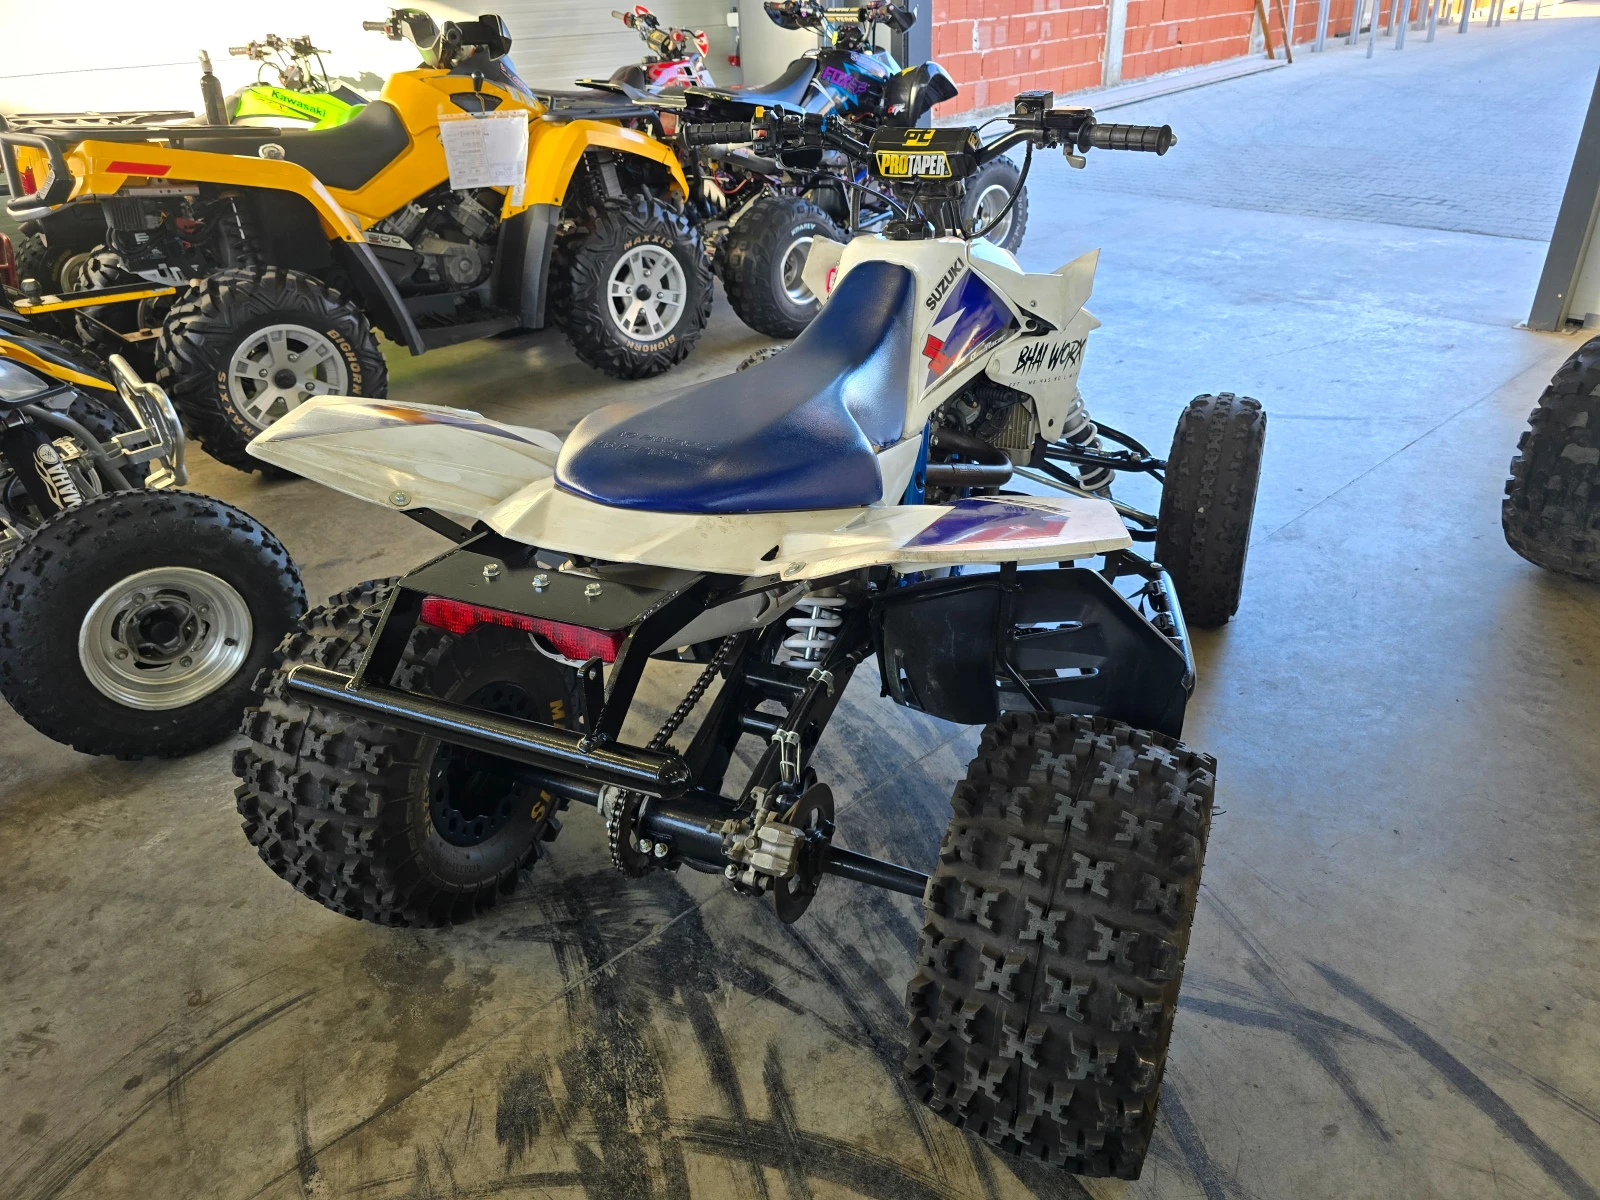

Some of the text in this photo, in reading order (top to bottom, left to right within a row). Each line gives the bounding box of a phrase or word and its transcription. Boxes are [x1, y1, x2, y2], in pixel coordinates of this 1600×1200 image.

[821, 65, 852, 89] FOX
[271, 89, 327, 119] Kawasaki
[881, 153, 947, 176] PROTAPER
[623, 234, 674, 251] MAXXIS
[925, 257, 965, 311] SUZUKI
[626, 333, 676, 353] BIGHORN
[326, 328, 362, 396] BIGHORN
[1011, 341, 1050, 377] BHAI
[217, 370, 255, 437] MAXXIS
